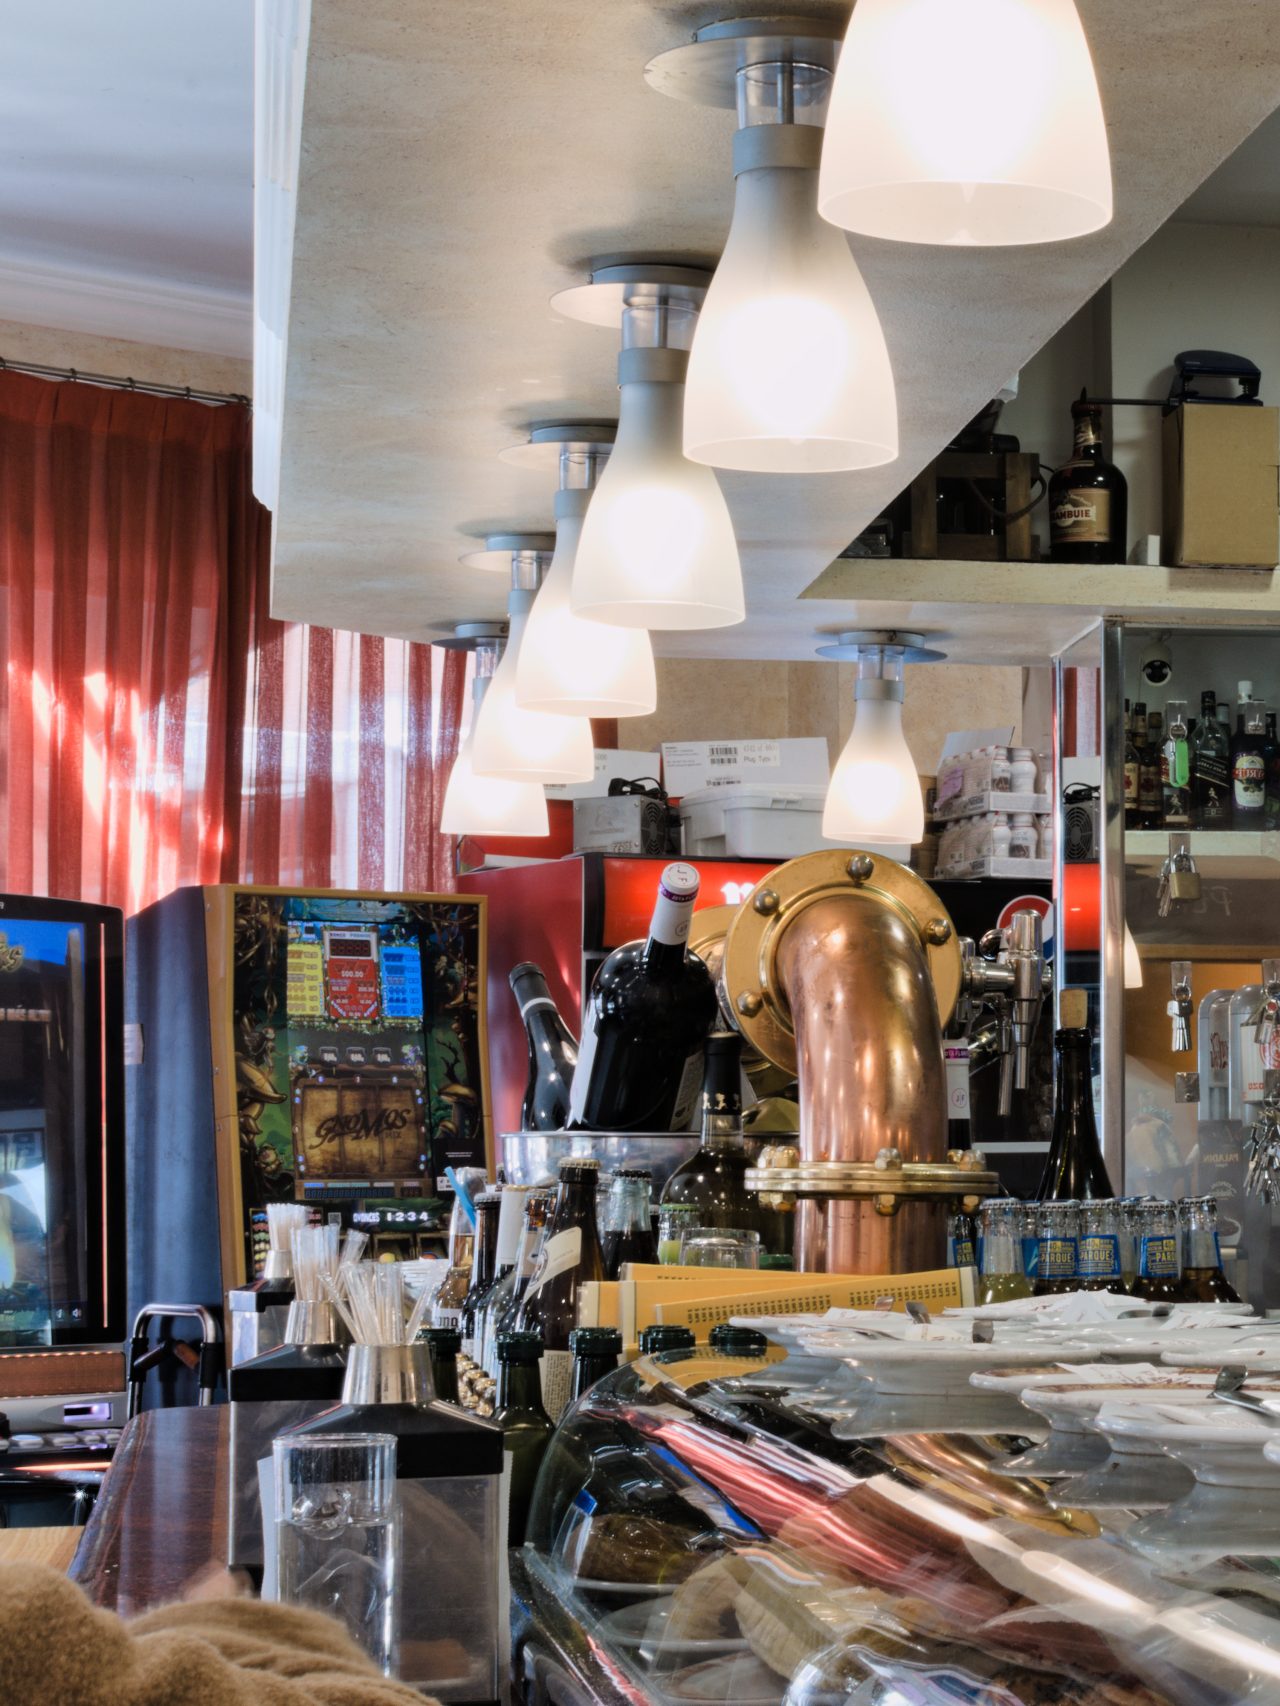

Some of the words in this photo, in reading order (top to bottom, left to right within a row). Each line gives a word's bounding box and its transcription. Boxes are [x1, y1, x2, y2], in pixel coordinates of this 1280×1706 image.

[1055, 509, 1091, 521] AMBUIE
[1040, 1251, 1074, 1263] PARQUE
[1079, 1249, 1111, 1261] PARQUE
